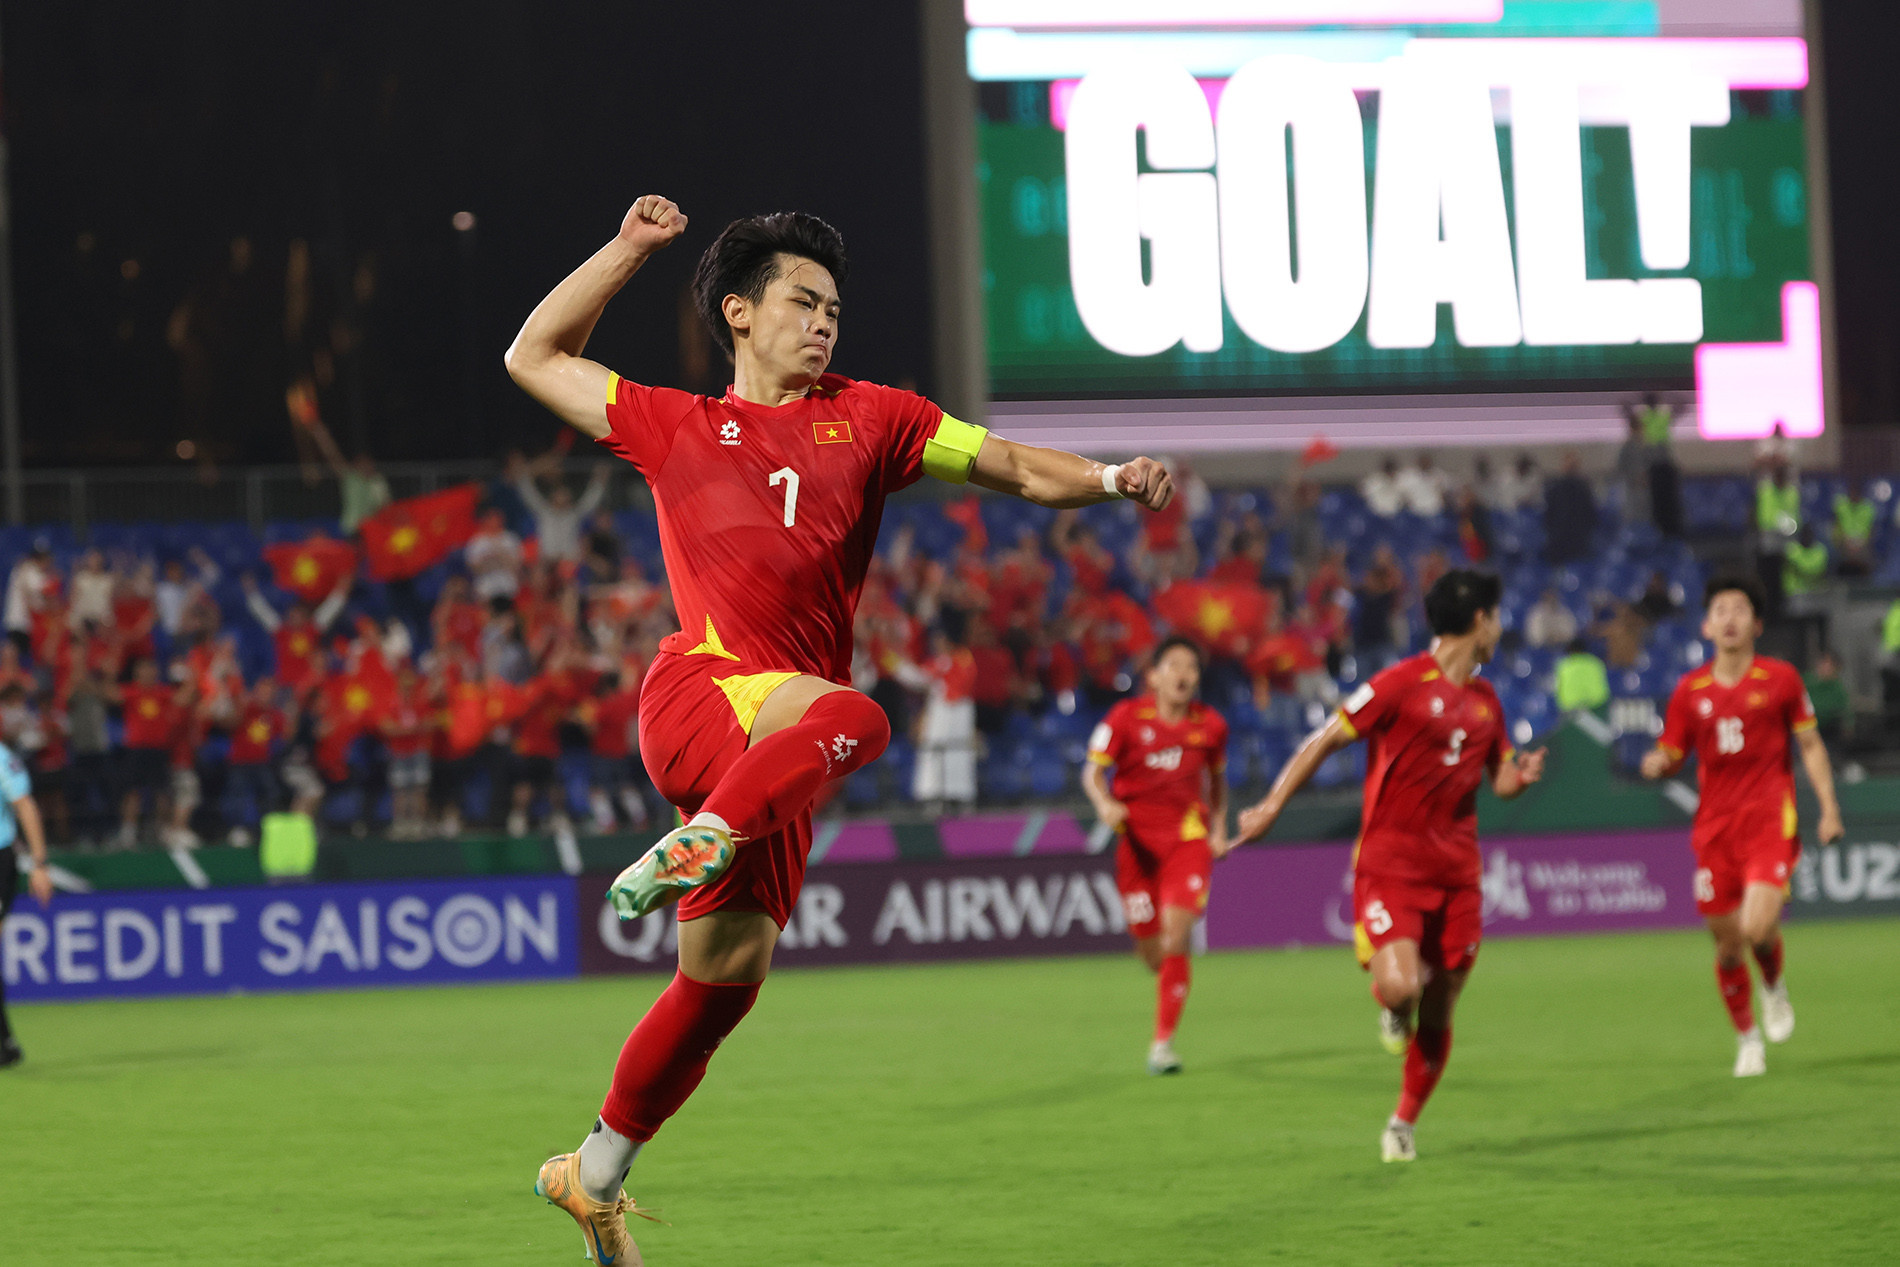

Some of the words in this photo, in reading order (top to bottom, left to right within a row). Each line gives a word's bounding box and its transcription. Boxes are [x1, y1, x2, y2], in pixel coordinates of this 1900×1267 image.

[1065, 54, 1706, 356] GOAL!
[768, 466, 800, 528] 7
[1716, 716, 1745, 755] 16
[258, 891, 559, 976] SAISON
[873, 871, 1128, 946] AIRWAY
[1364, 899, 1394, 935] 5
